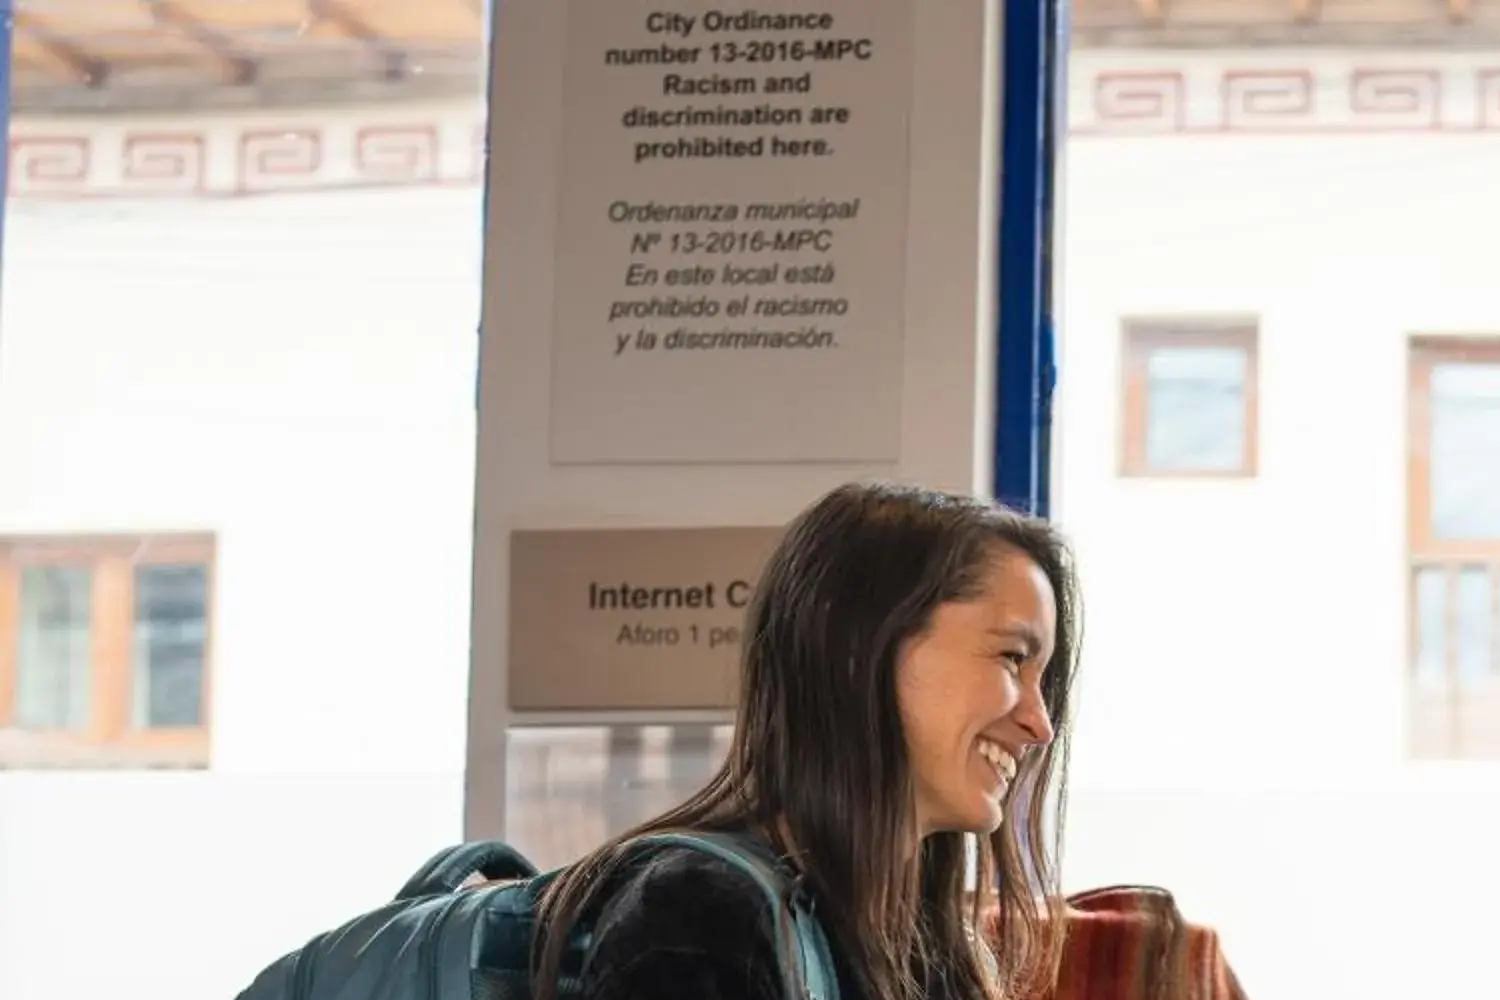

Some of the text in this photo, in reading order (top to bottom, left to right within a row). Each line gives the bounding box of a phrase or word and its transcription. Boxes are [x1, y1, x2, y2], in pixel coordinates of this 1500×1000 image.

[645, 10, 834, 38] City Ordinance
[604, 38, 873, 65] number 13-2016-MPC
[663, 72, 811, 95] Racism and
[622, 106, 850, 128] discrimination are
[634, 135, 834, 162] prohibited here.
[607, 198, 861, 224] Ordenanza municipal
[670, 228, 834, 254] 13-2016-MPC
[624, 262, 836, 287] En este local está
[608, 296, 850, 323] prohibido el racismo
[615, 327, 840, 356] y la discriminación.
[588, 580, 750, 610] Internet C
[615, 623, 681, 646] Aforo
[688, 624, 699, 644] 1
